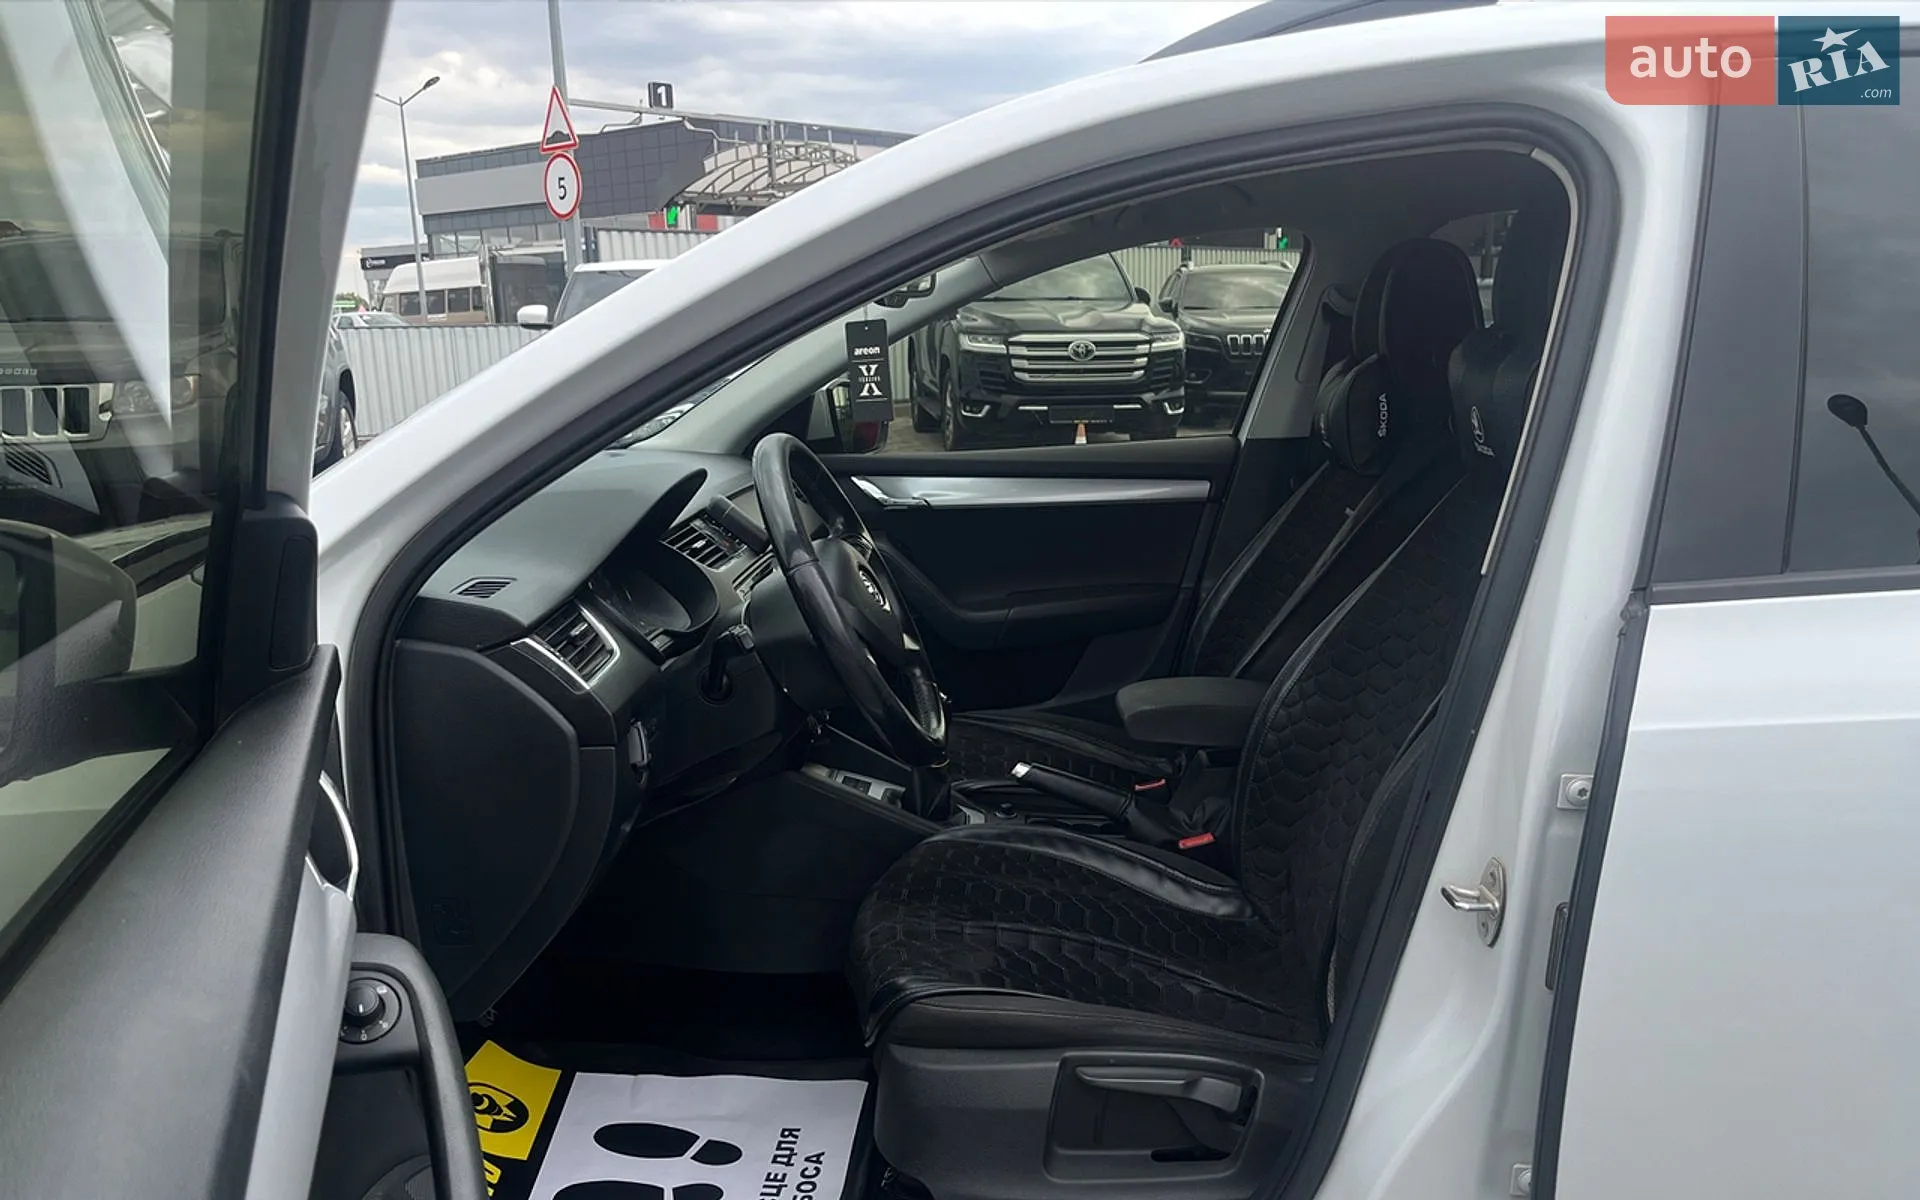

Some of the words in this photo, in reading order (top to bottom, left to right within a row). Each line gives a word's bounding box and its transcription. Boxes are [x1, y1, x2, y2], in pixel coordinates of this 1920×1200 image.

[656, 85, 667, 106] 1
[557, 176, 567, 200] 5
[853, 346, 881, 356] areon
[771, 1127, 801, 1167] ДЛЯ
[759, 1172, 788, 1200] ЦЕ
